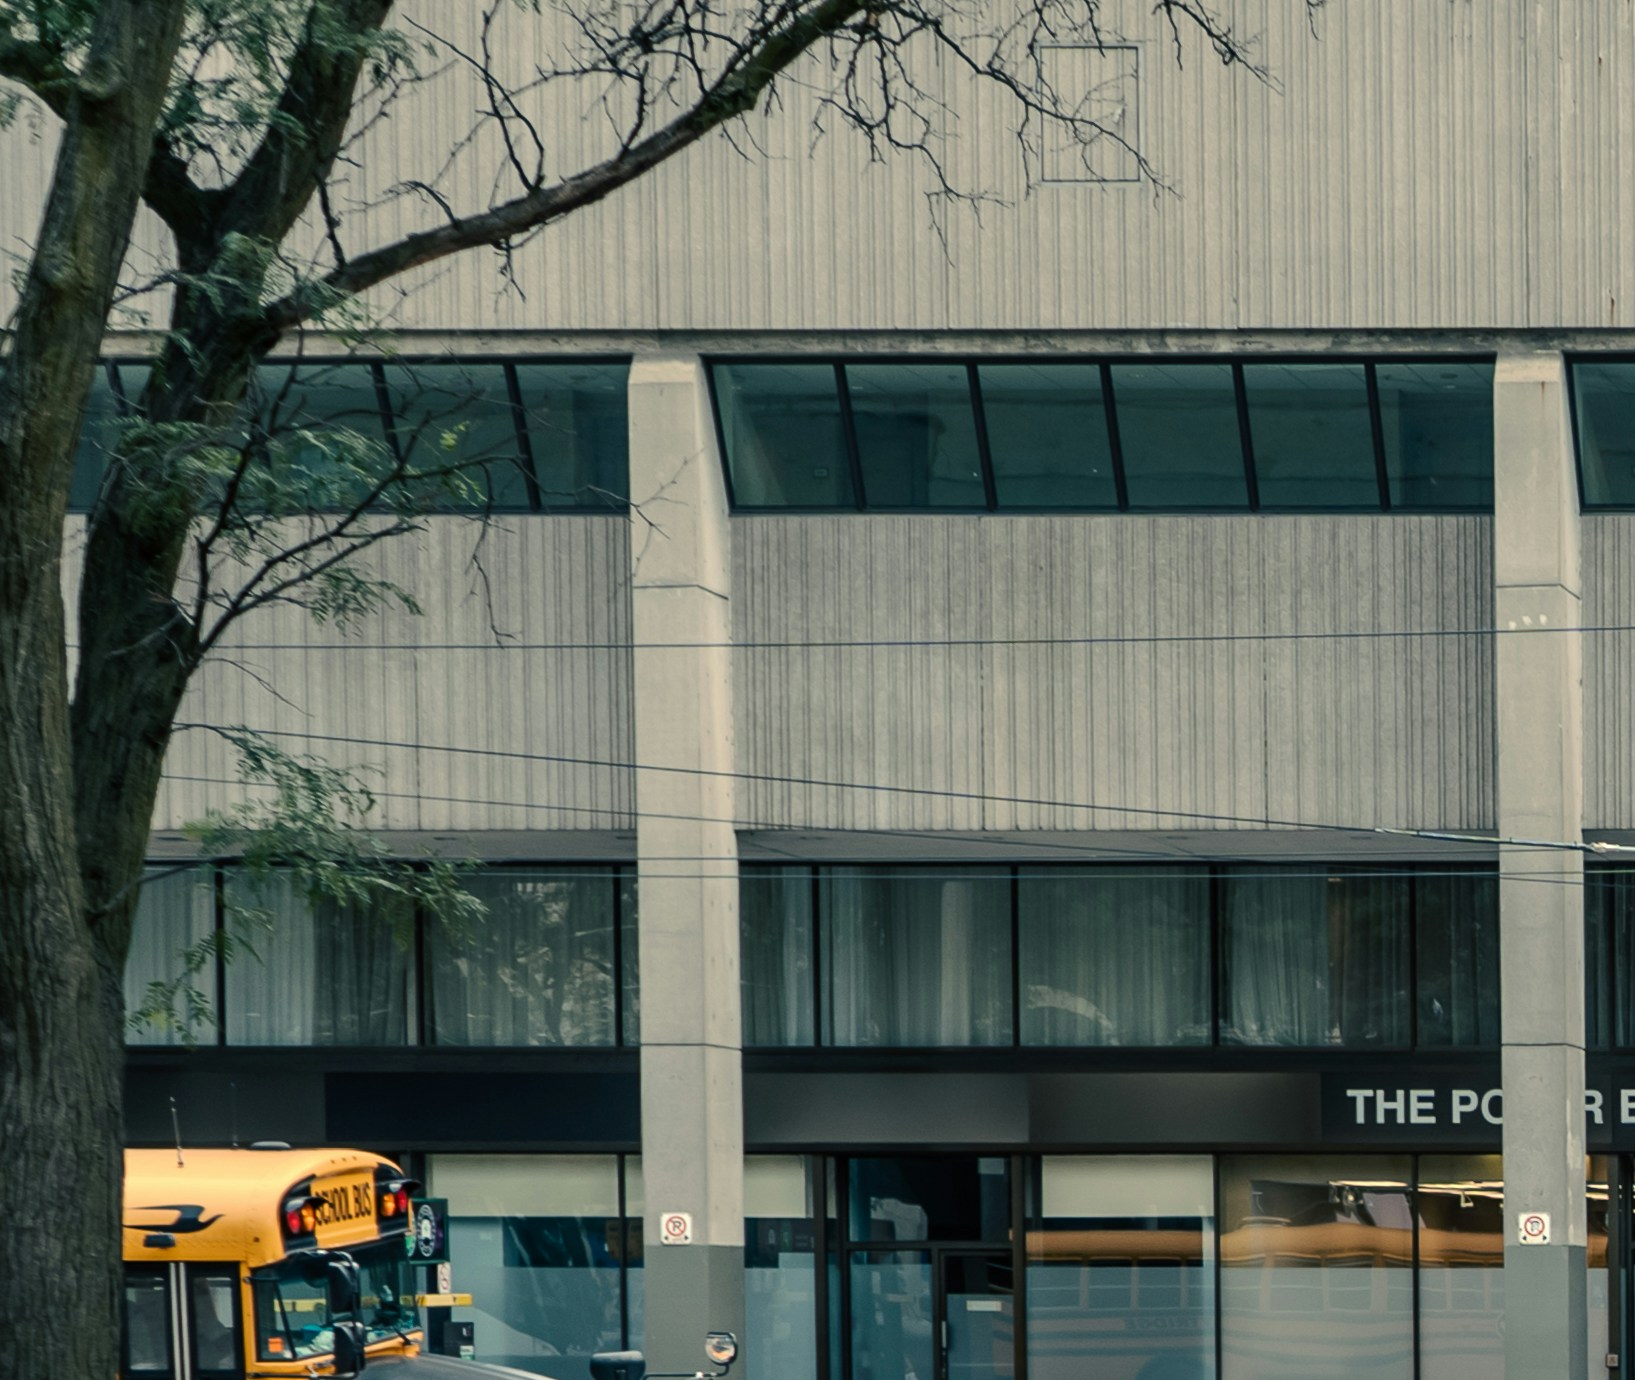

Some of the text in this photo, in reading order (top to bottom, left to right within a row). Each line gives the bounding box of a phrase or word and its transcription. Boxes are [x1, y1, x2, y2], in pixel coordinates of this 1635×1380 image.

[1346, 1089, 1437, 1124] THE
[1452, 1089, 1604, 1124] POR
[353, 1181, 372, 1219] BUS
